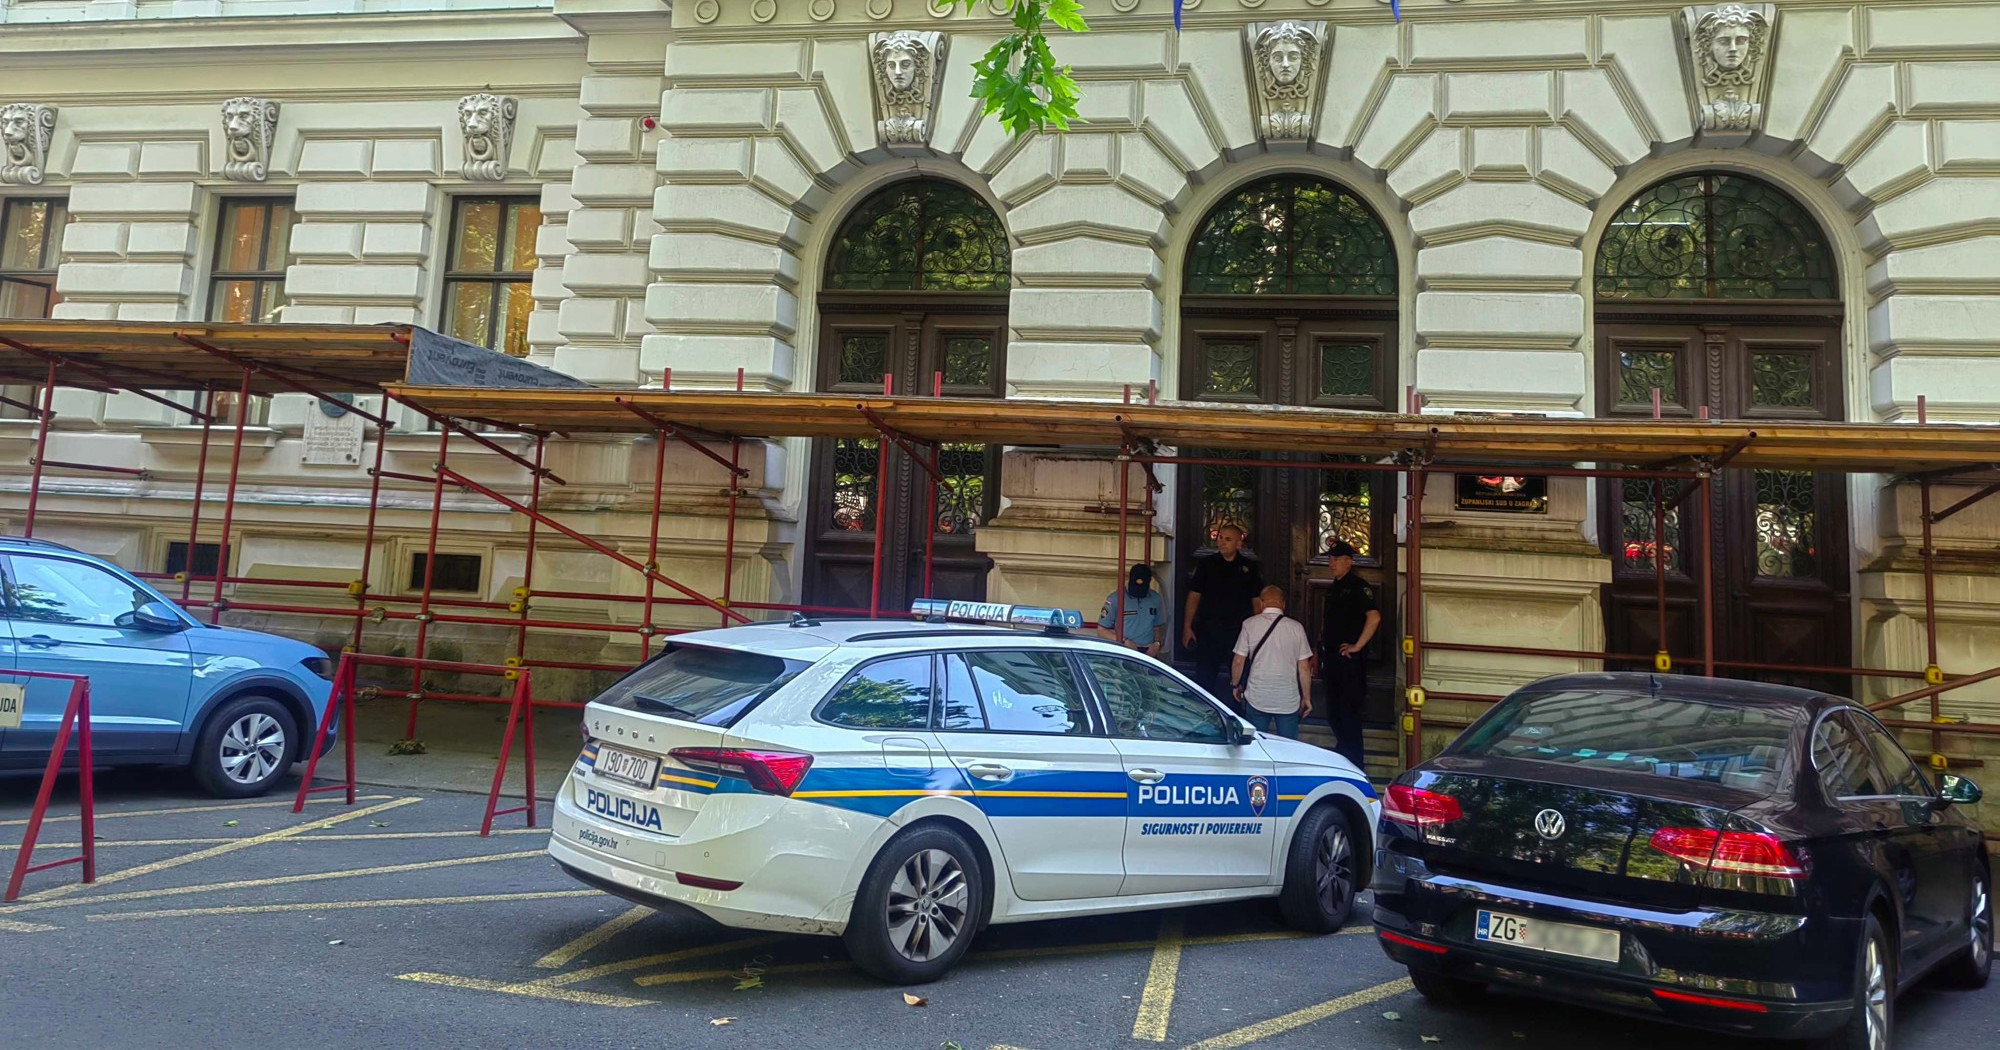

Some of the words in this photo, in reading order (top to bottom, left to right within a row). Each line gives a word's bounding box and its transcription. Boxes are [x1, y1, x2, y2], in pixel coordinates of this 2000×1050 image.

[951, 602, 1005, 620] POLICIJA
[604, 751, 623, 773] 190
[626, 756, 648, 780] 700
[1138, 785, 1240, 805] POLICIJA
[587, 789, 663, 831] POLICIJA
[578, 829, 618, 849] policija.gov.hr
[1141, 823, 1199, 836] SIGURNOST
[1200, 823, 1205, 835] I
[1206, 822, 1263, 835] POVJERENJE
[1491, 915, 1517, 941] ZG
